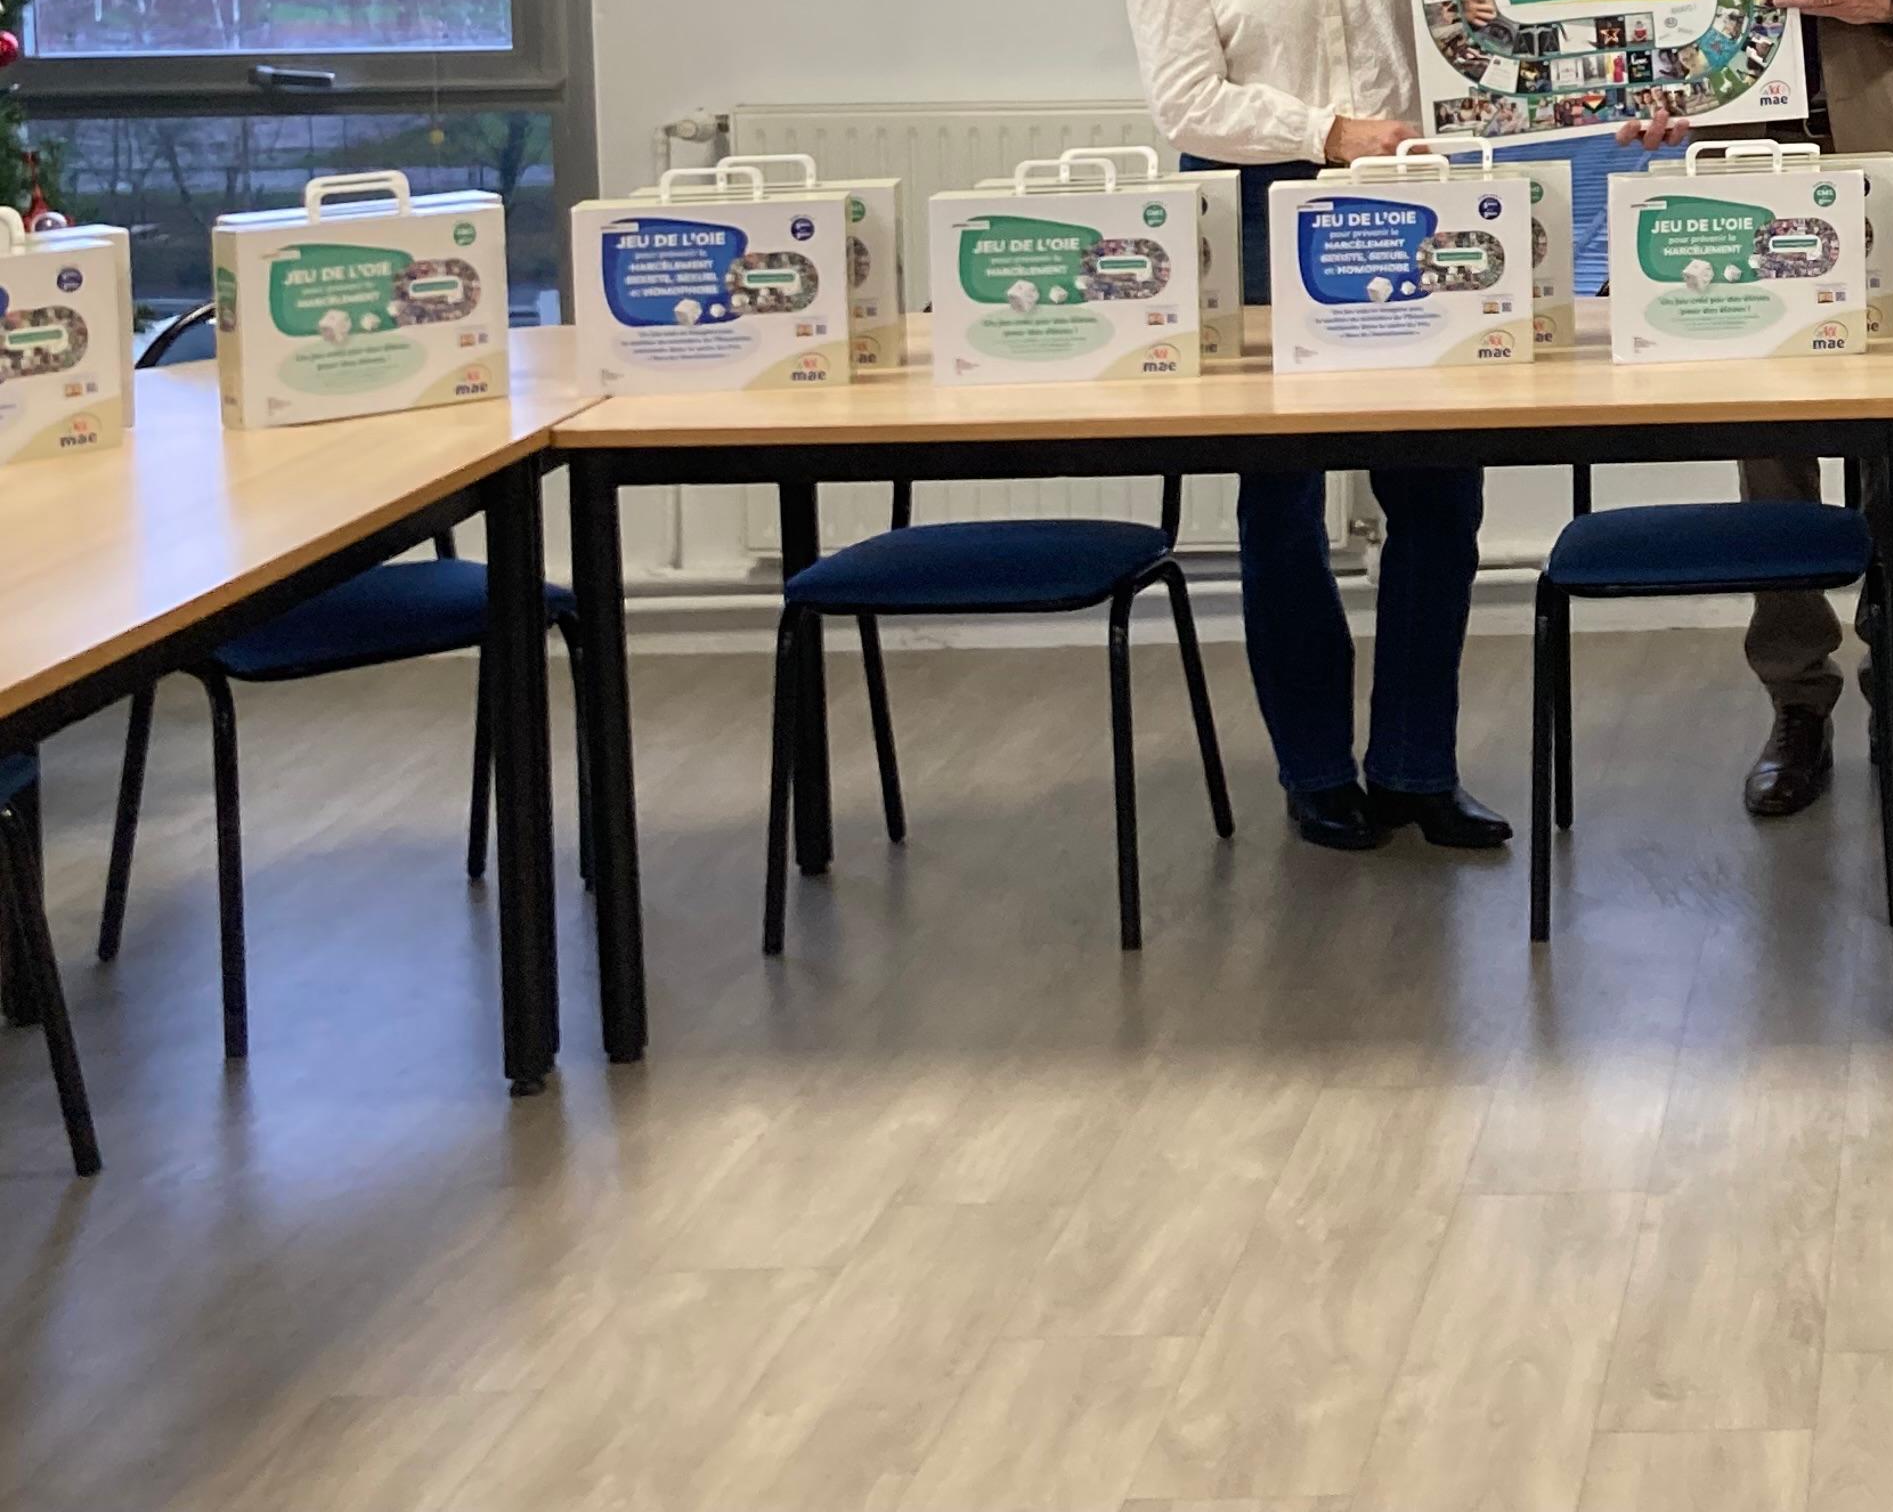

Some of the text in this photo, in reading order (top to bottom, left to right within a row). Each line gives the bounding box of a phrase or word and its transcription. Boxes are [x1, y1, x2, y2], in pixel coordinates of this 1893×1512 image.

[1759, 93, 1789, 107] mae
[1311, 209, 1417, 228] JEU DE L'OIE
[1651, 217, 1753, 234] JEU DE L'OIE
[616, 231, 726, 249] JEU DE L'OIE
[973, 239, 1006, 254] JEU
[1010, 238, 1033, 252] DE
[1535, 332, 1553, 343] ae
[1812, 339, 1845, 350] mae
[857, 353, 877, 364] ae
[1478, 347, 1511, 359] mae
[1143, 361, 1177, 373] mae
[790, 370, 827, 382] mae
